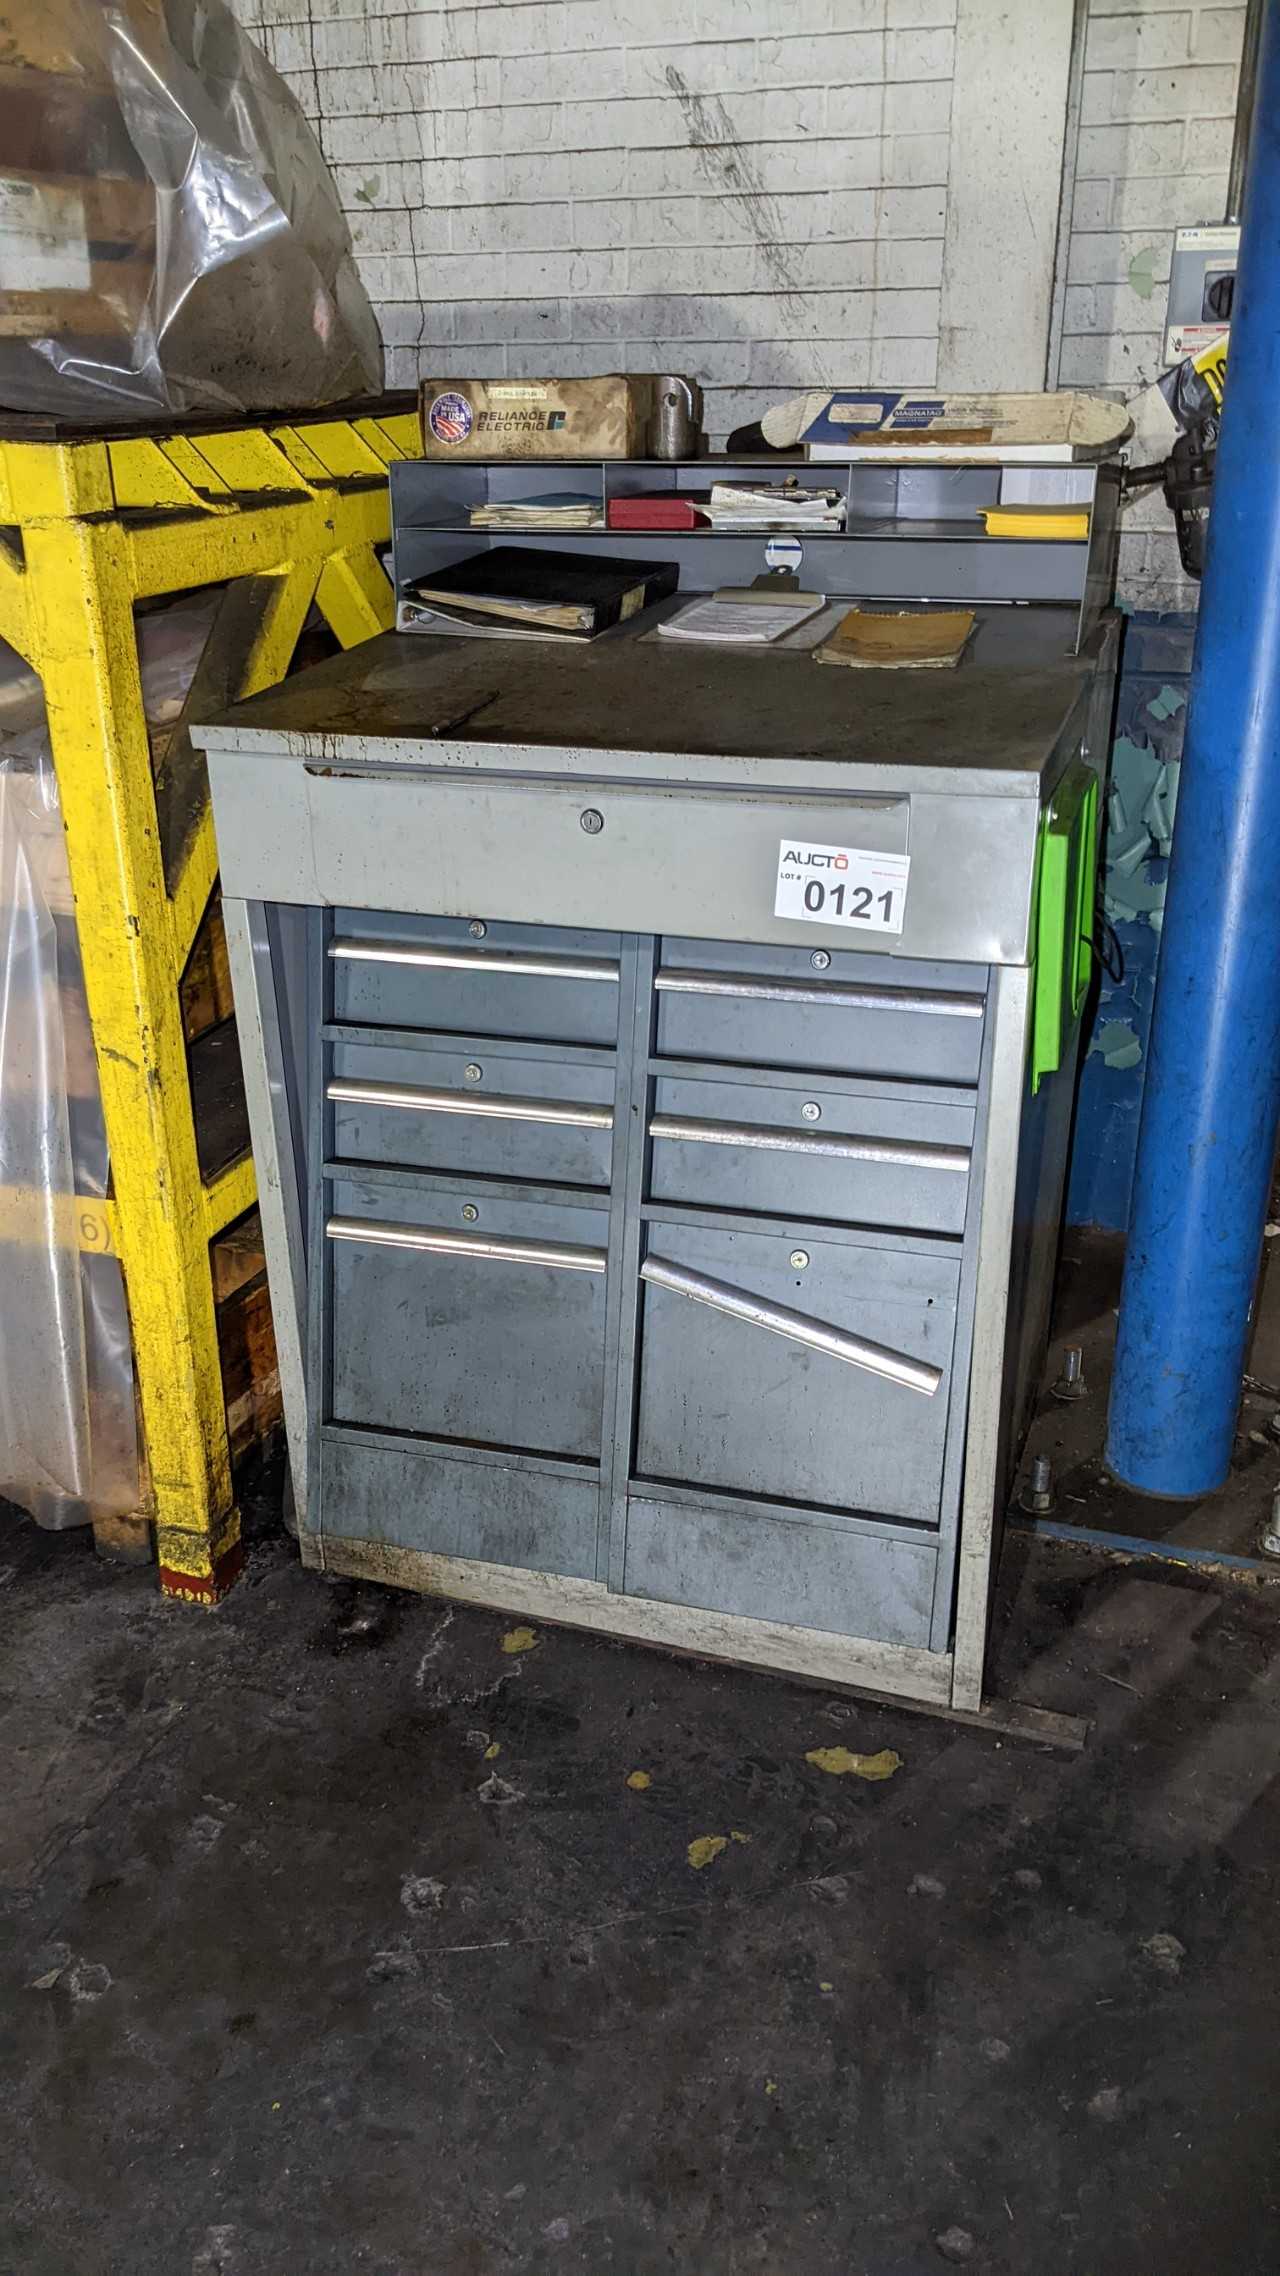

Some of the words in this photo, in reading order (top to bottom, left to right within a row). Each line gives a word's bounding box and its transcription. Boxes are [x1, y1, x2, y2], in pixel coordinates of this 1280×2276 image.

[448, 412, 466, 422] USA
[478, 411, 547, 421] RELIANCE
[476, 422, 546, 431] ELECTRIC
[780, 872, 795, 880] LOT
[804, 880, 893, 923] 0121
